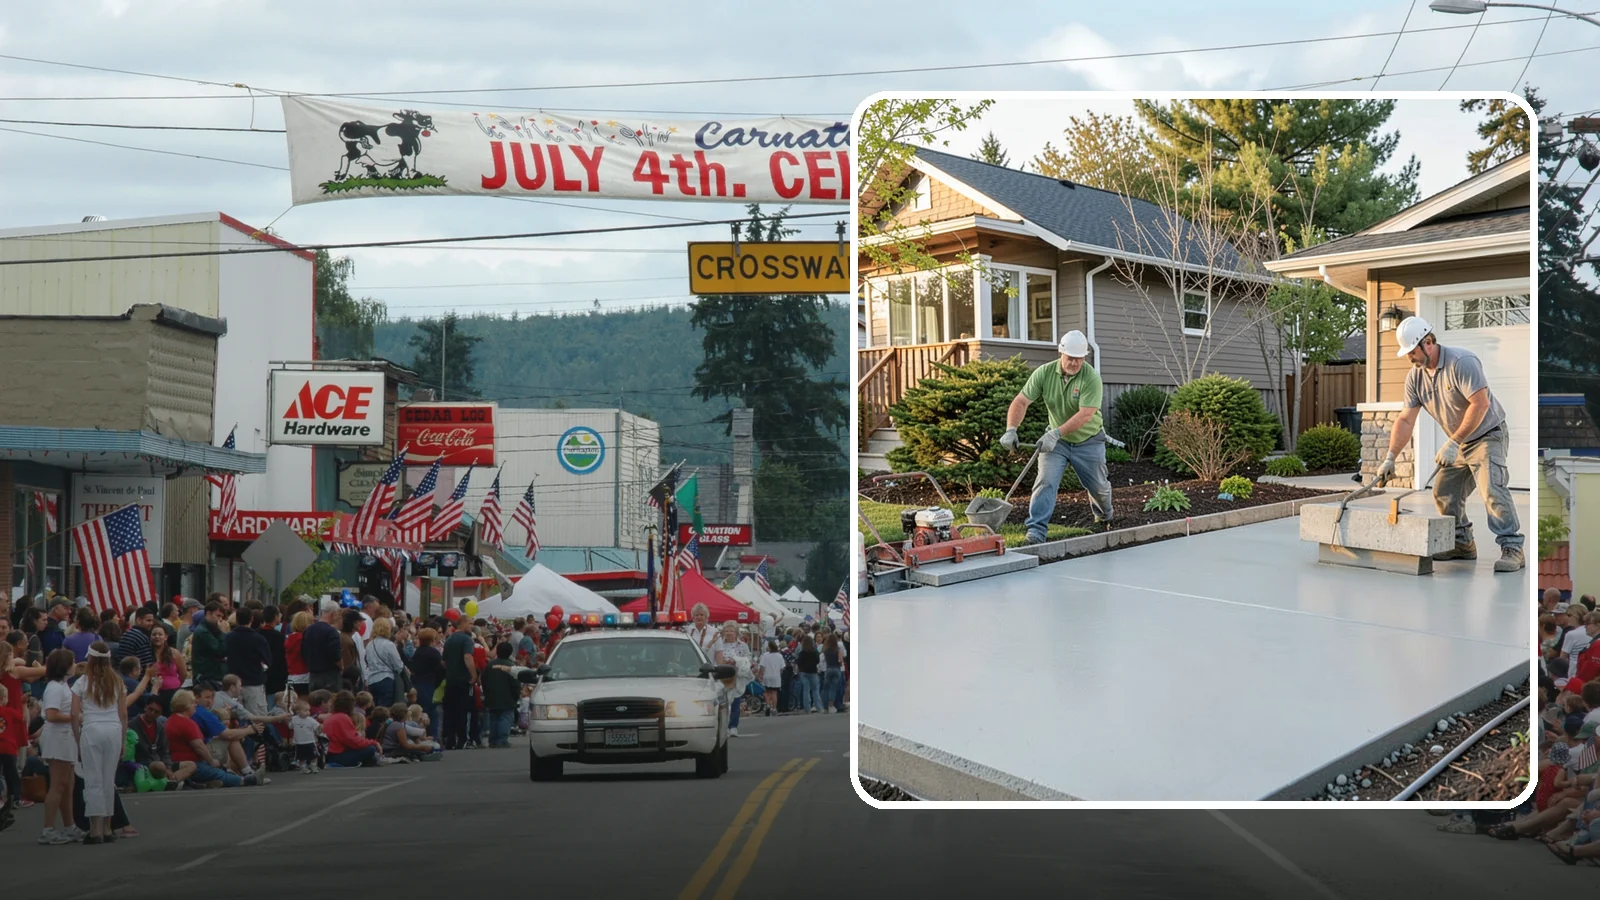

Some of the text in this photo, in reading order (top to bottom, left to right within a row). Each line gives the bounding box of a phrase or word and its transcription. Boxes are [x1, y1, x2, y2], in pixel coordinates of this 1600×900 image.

[695, 121, 850, 149] Carnat
[481, 141, 605, 191] JULY
[632, 150, 746, 197] 4th.
[697, 254, 850, 279] CROSSWA
[282, 380, 373, 420] ACE
[406, 409, 485, 421] CEDAR LOG
[283, 421, 370, 436] Hardware
[416, 428, 477, 447] Coca-Cola
[353, 467, 385, 480] Simpl
[83, 484, 155, 495] St. Vincent de Paul
[80, 503, 154, 522] THRT
[688, 526, 741, 535] CRNATION
[699, 535, 730, 543] GLASS
